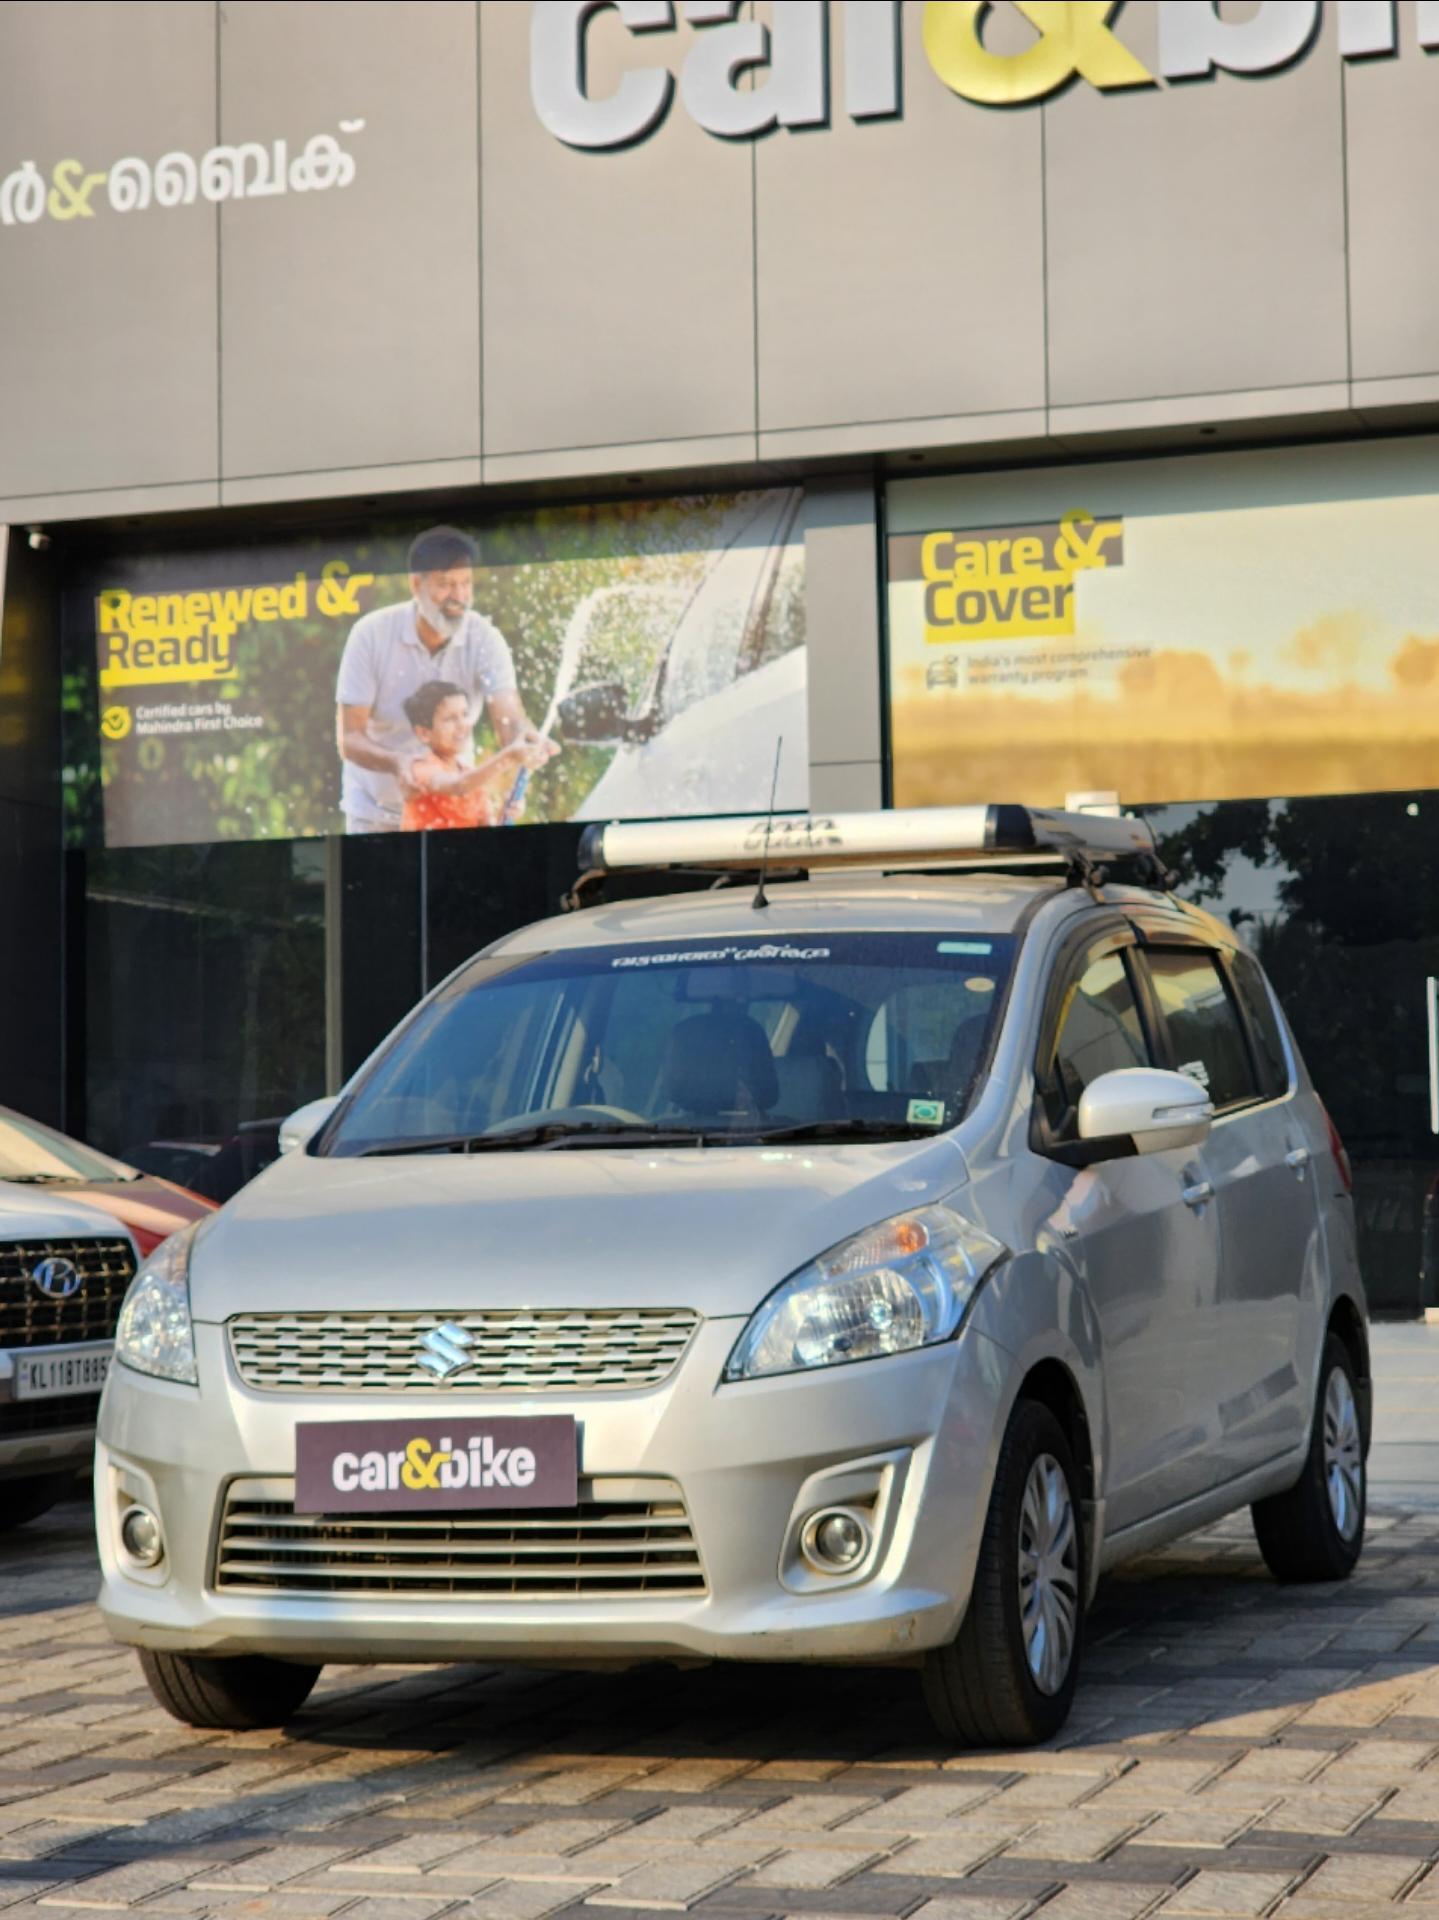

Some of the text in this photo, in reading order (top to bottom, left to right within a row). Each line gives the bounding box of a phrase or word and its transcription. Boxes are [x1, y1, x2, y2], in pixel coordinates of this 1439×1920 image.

[921, 508, 1123, 580] Care &
[100, 560, 374, 632] Renewed &
[924, 579, 1074, 627] Cover
[100, 626, 237, 674] Ready
[30, 1356, 113, 1390] KL11BT885
[332, 1436, 536, 1492] car&bike
